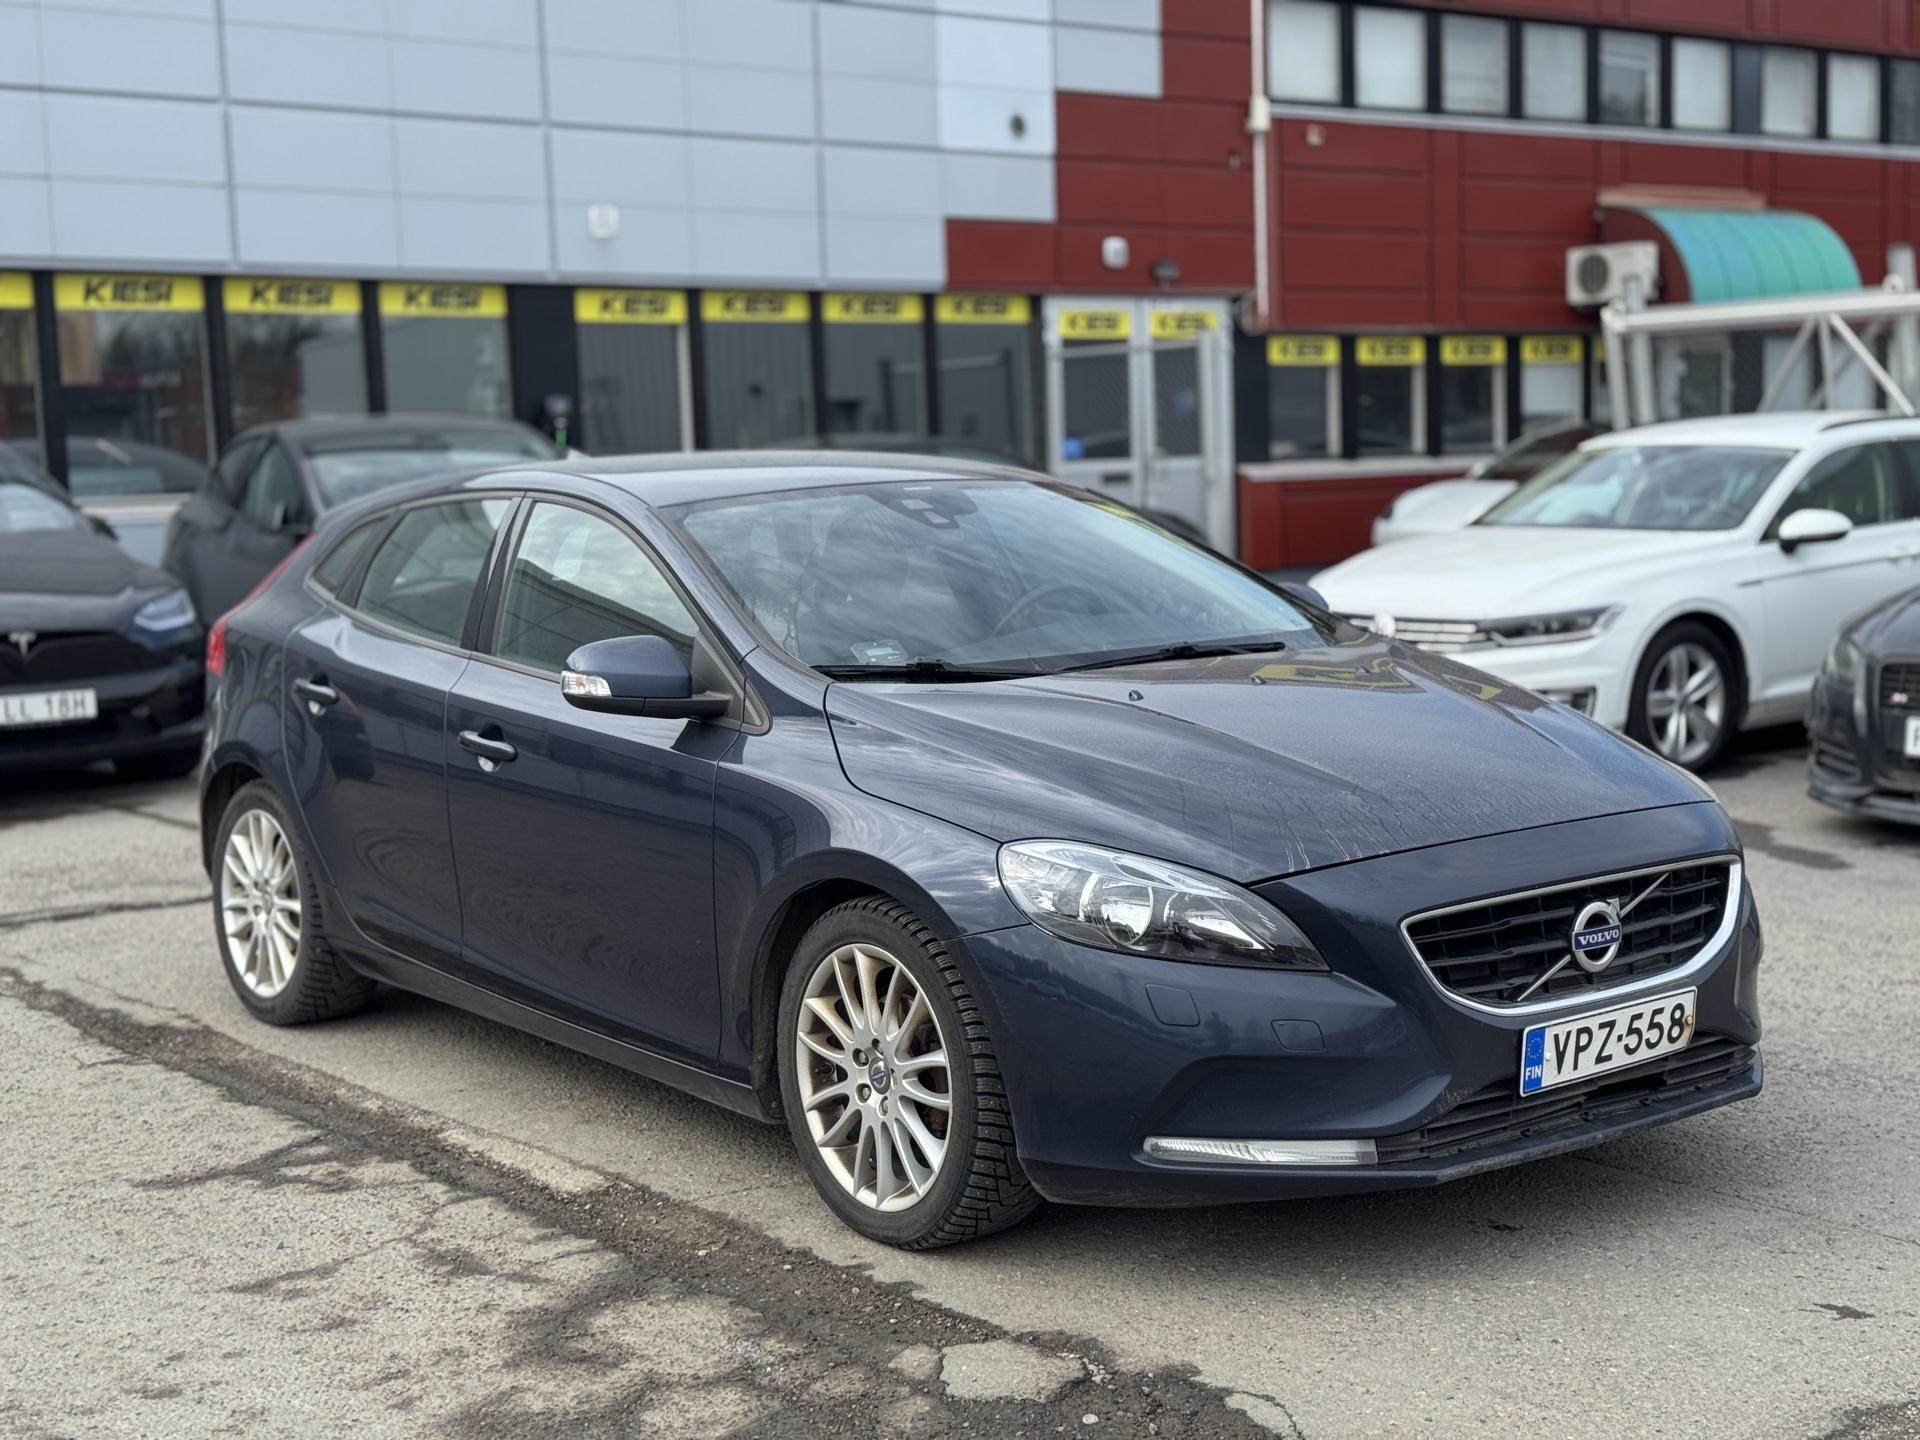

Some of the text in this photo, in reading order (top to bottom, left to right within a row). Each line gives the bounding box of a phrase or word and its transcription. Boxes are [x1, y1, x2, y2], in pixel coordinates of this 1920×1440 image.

[83, 277, 175, 303] KIESI
[252, 279, 333, 305] KIESI
[403, 282, 482, 308] KIESI
[1578, 929, 1619, 945] VOLVO
[1553, 1003, 1686, 1075] VPZ-558
[1525, 1064, 1542, 1081] FIN
